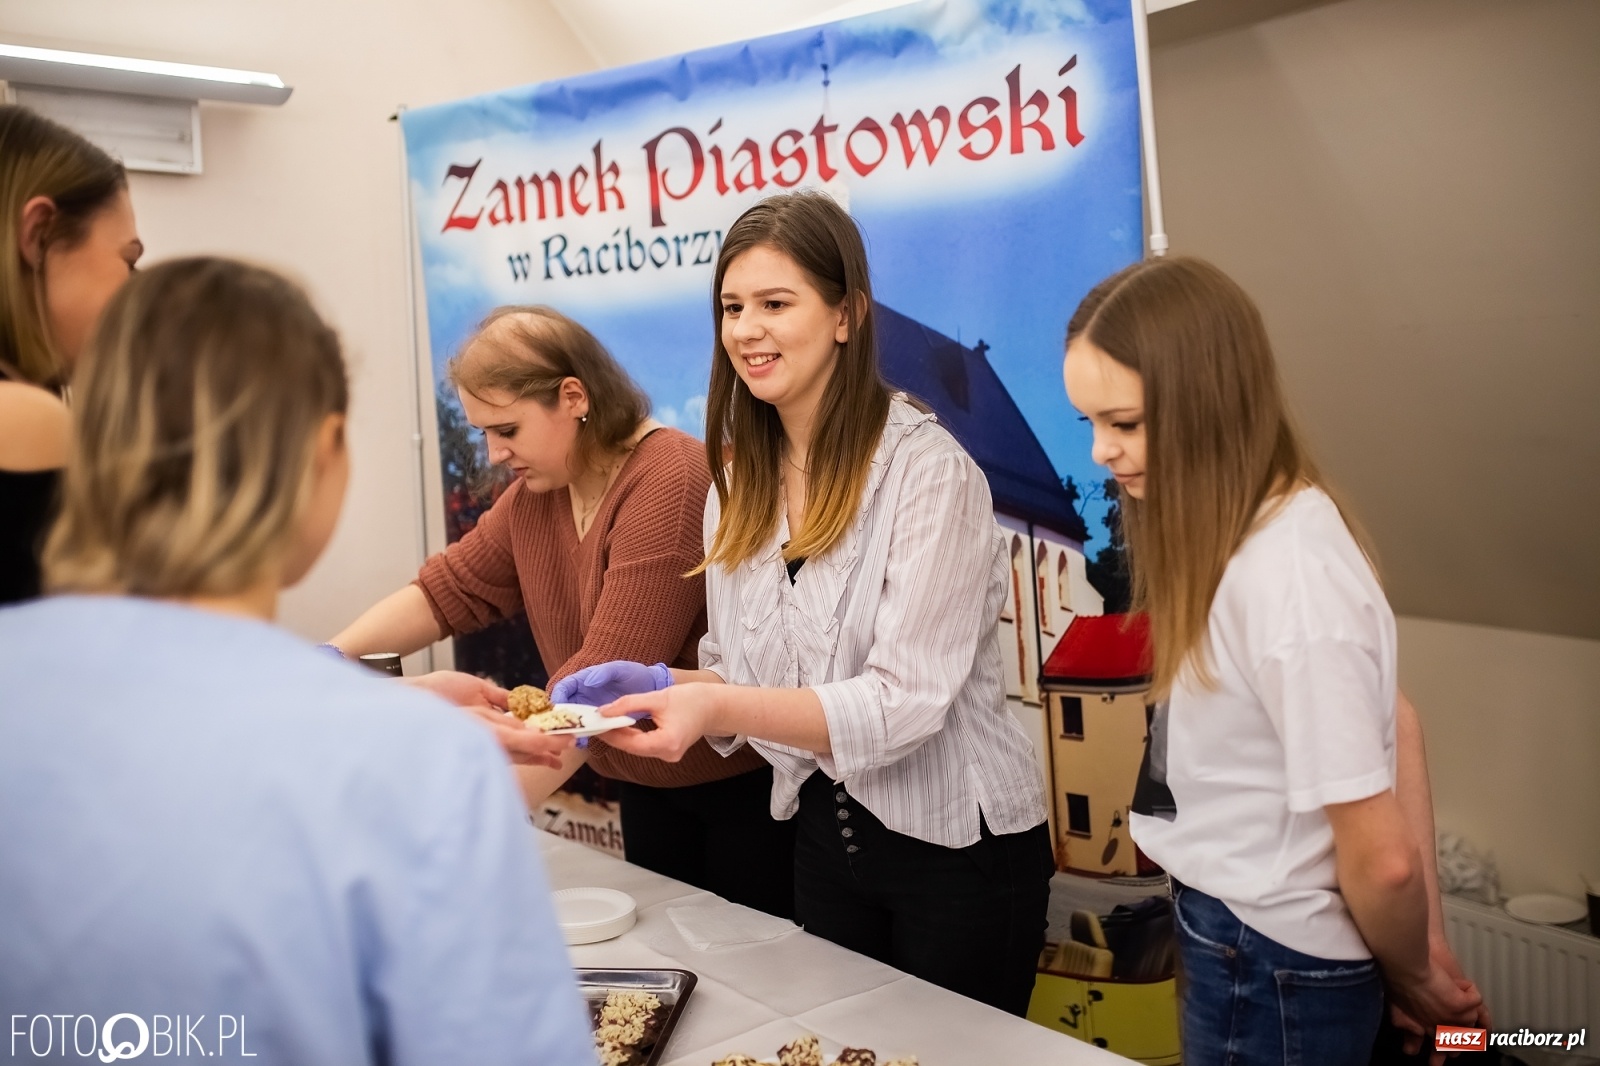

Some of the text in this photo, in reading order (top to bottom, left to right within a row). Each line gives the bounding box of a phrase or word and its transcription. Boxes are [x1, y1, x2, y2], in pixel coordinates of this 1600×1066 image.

[440, 53, 1086, 233] Zamek Piastowski
[506, 251, 531, 282] w
